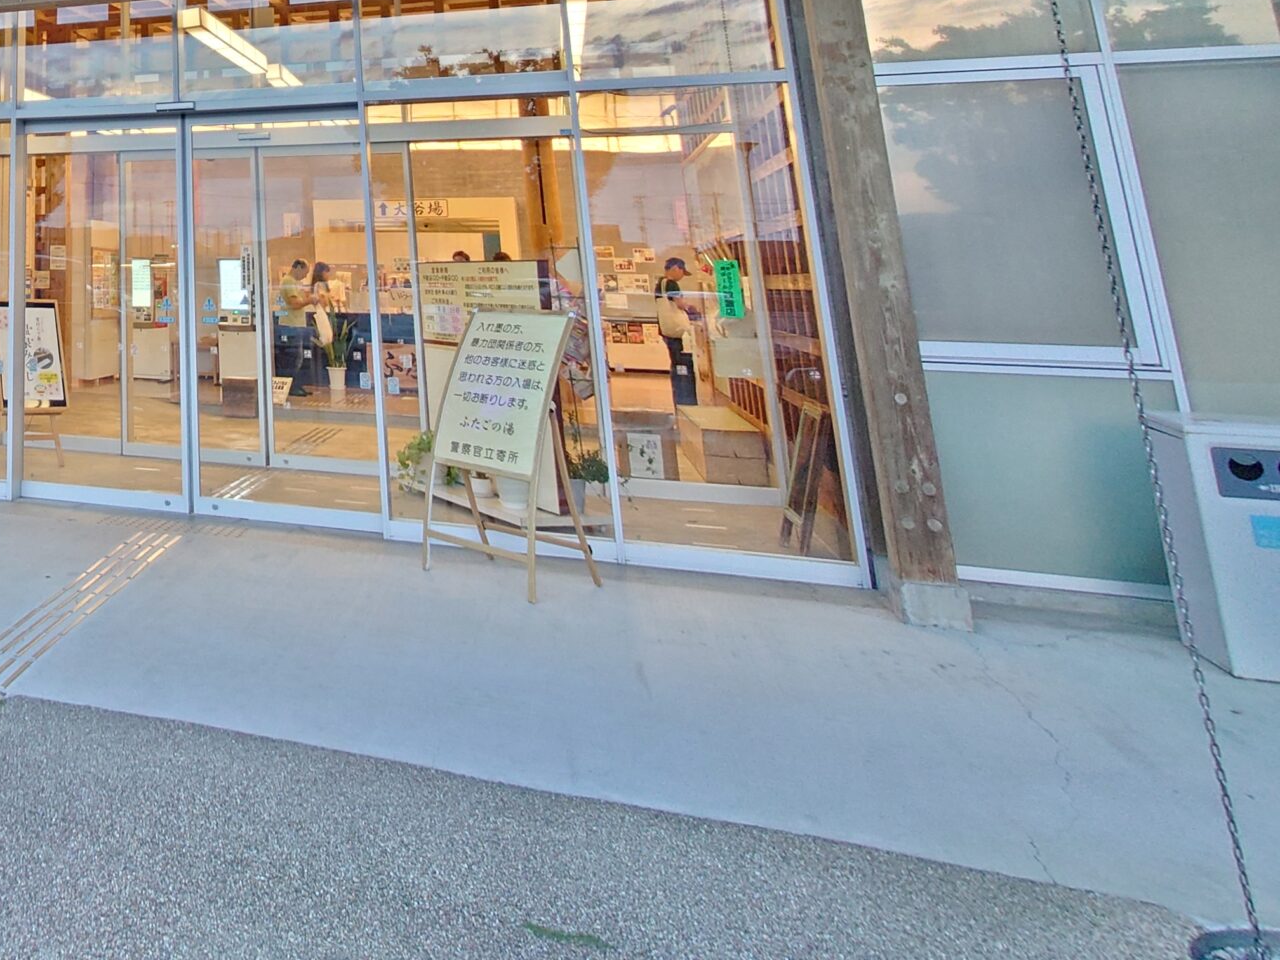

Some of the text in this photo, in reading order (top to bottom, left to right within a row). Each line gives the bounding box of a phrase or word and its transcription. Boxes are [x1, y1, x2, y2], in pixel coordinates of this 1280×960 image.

[471, 338, 544, 353] 暴力団関係者の方、
[464, 354, 545, 371] 他のお客様に迷惑と
[458, 371, 543, 391] 思われる方の入場は、
[454, 391, 528, 410] 一切お断りします。
[460, 416, 515, 436] ふたごの湯
[450, 441, 519, 464] 警察官立寄所
